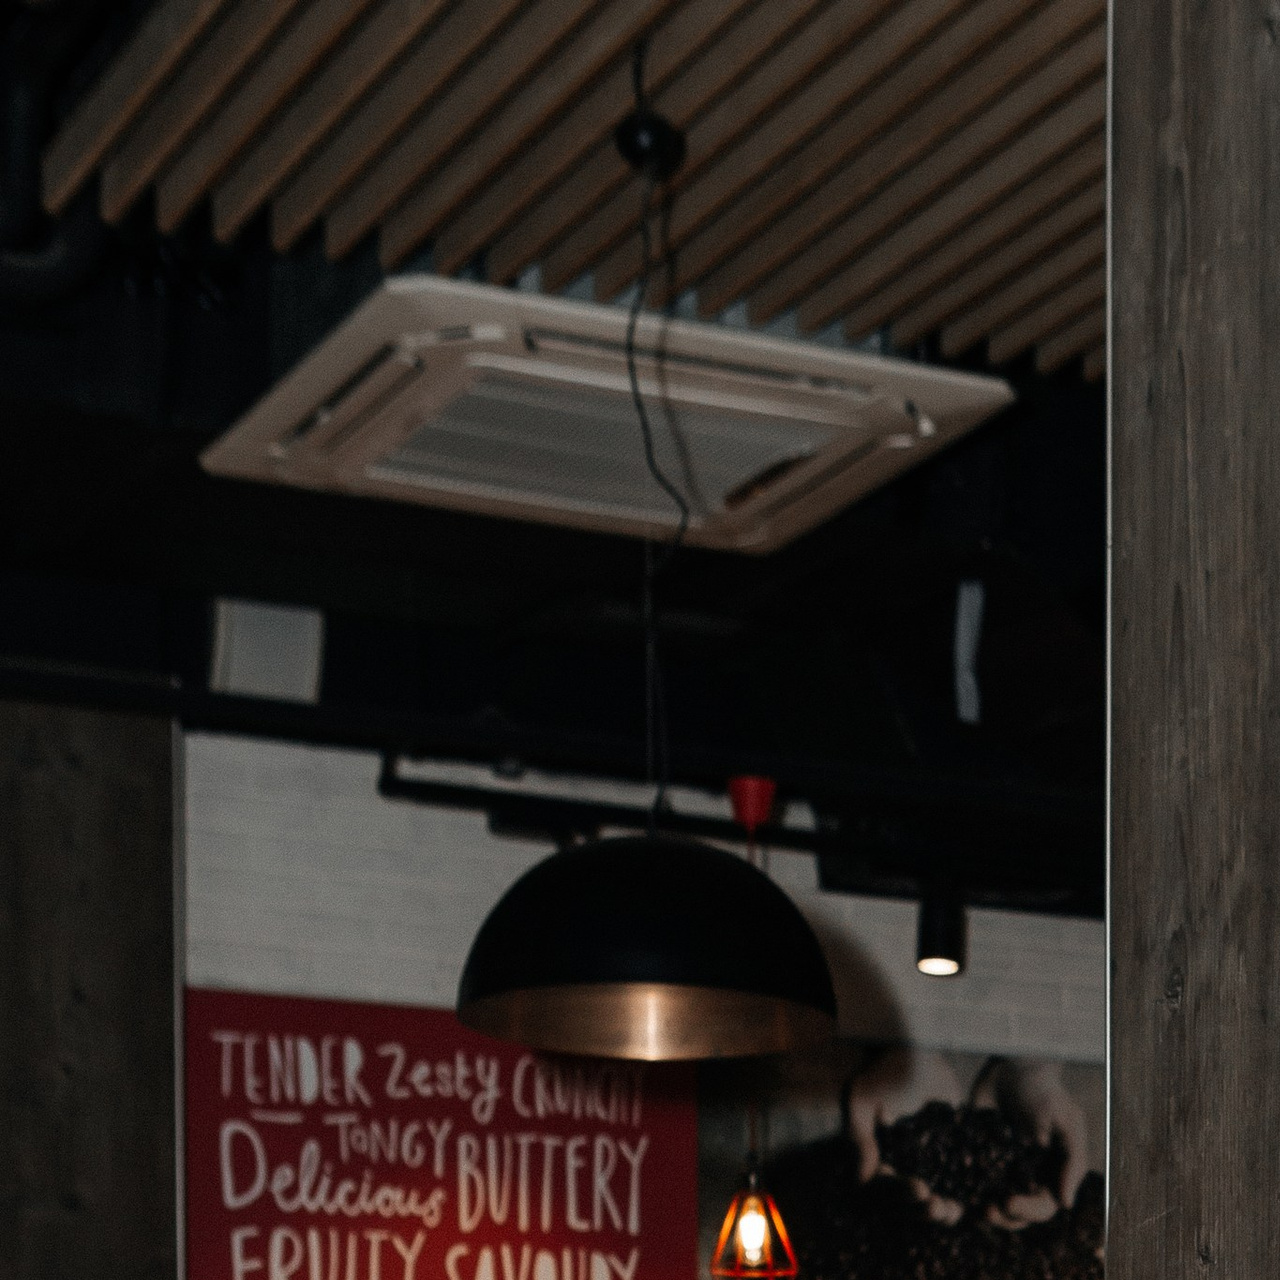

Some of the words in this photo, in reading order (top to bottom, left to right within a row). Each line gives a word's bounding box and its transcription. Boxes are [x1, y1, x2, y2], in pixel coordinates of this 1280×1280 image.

[212, 1029, 370, 1107] TENDER
[379, 1043, 499, 1124] Zesty
[218, 1119, 450, 1229] Delicious
[457, 1131, 649, 1237] BUTTERY
